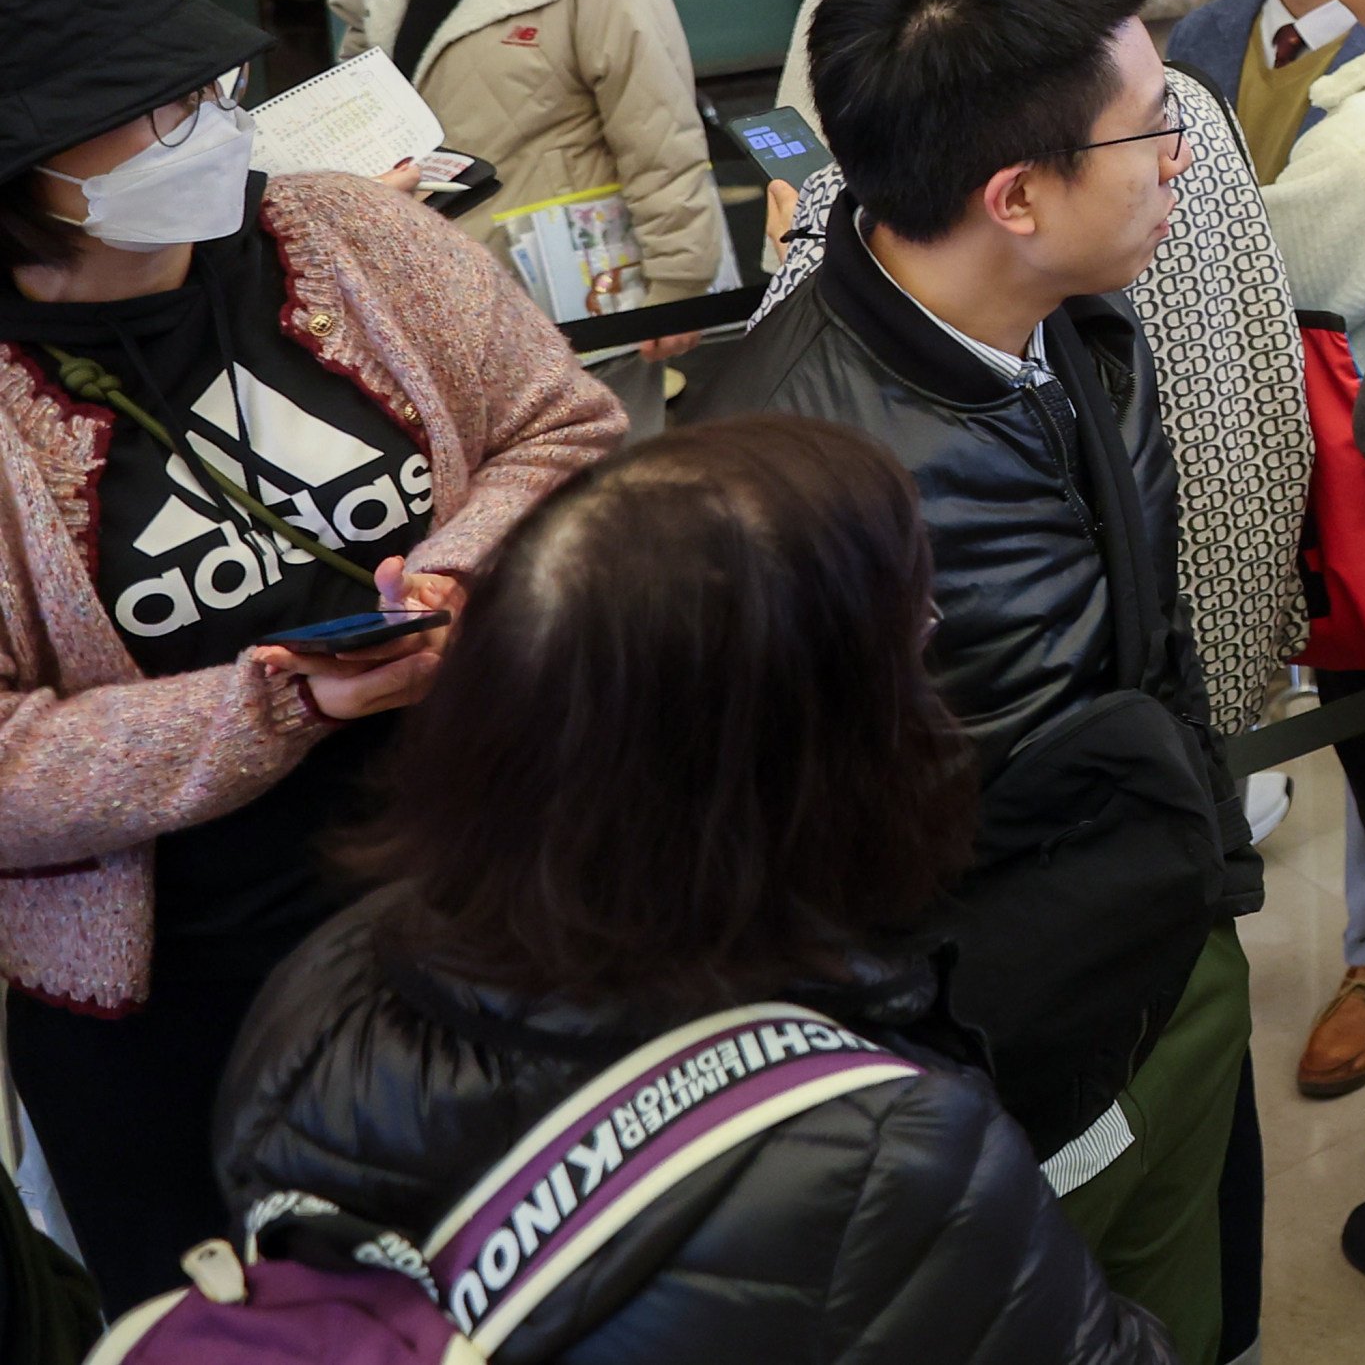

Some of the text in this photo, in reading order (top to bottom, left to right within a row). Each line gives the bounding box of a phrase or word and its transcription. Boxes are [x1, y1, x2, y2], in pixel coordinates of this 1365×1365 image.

[115, 453, 434, 637] adidas
[609, 1038, 738, 1135] EDITION
[619, 1060, 749, 1150] LIMITED
[449, 1118, 623, 1336] KINOU
